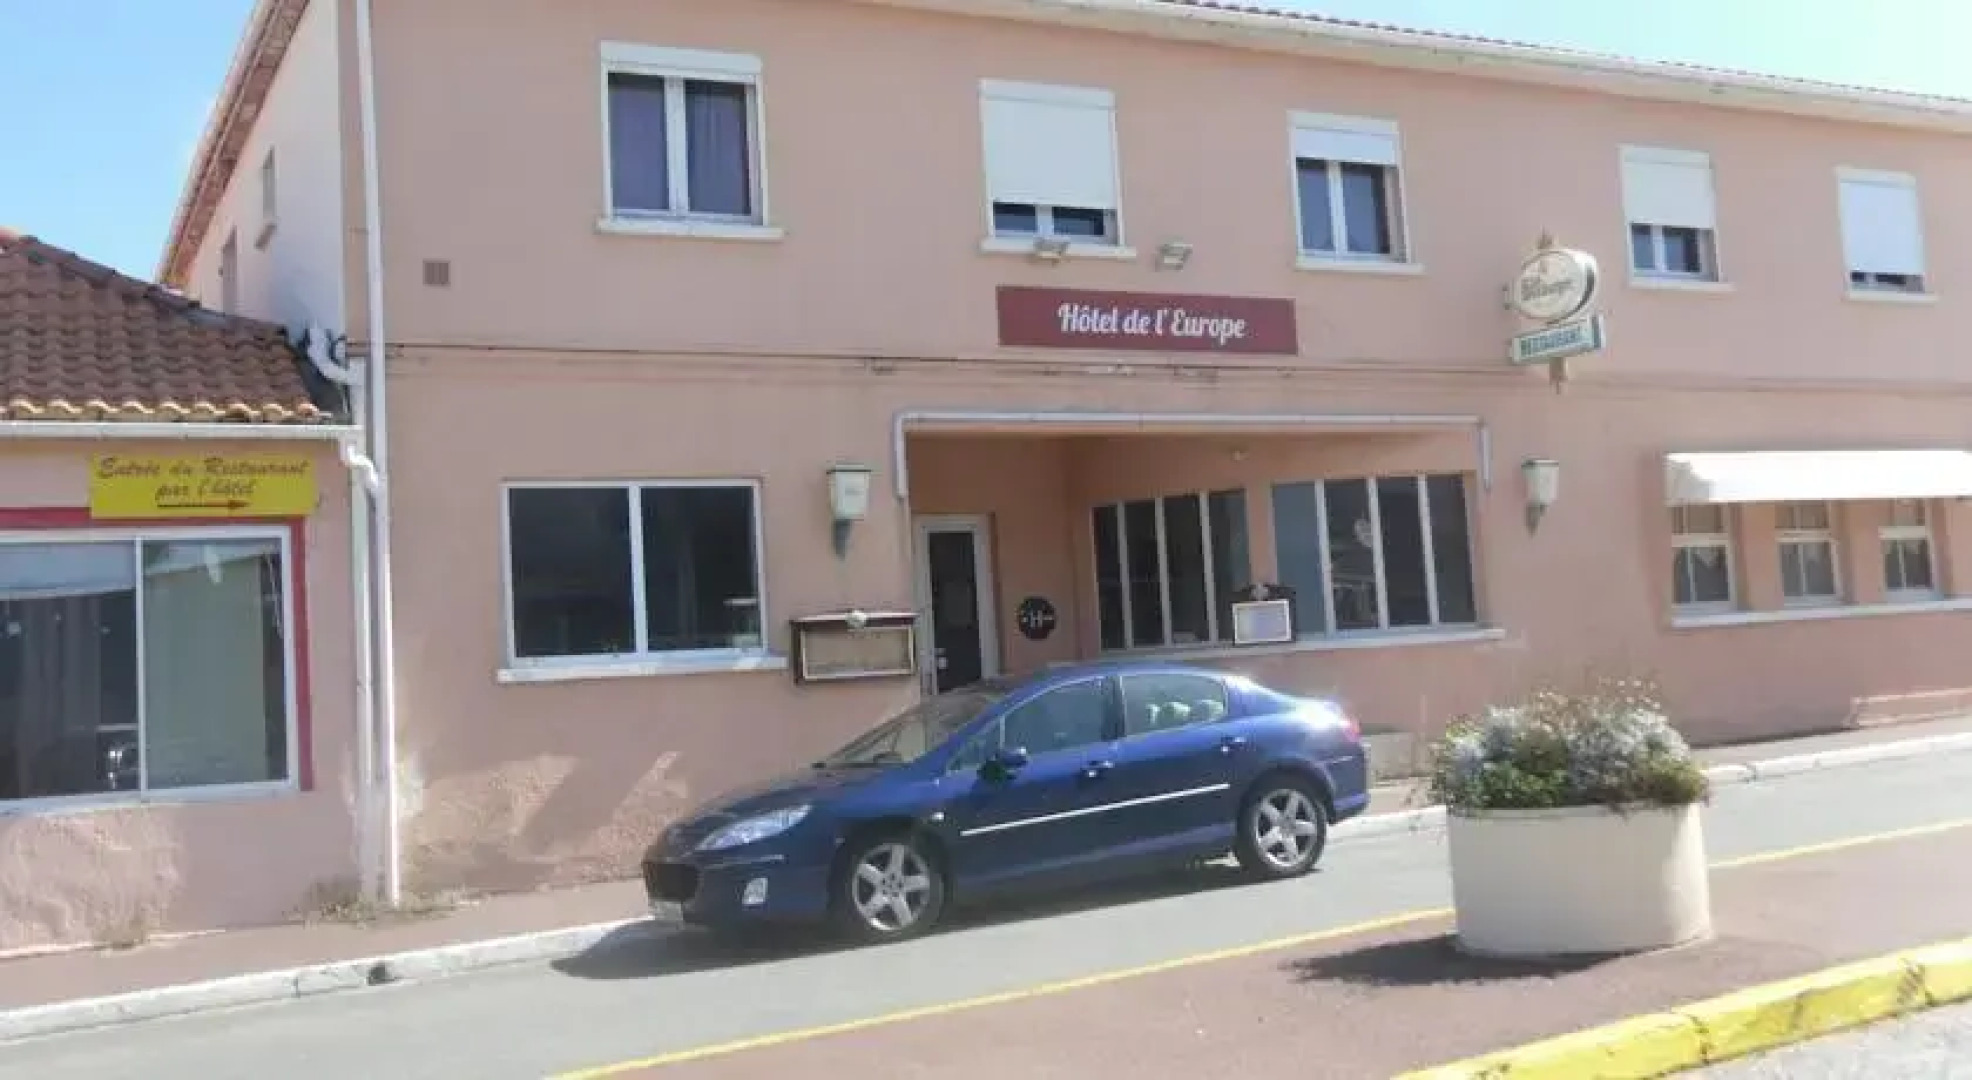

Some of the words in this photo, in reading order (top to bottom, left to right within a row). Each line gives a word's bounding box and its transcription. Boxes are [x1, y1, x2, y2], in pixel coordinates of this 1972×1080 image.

[1058, 302, 1118, 333] Hôtel
[1123, 308, 1150, 334] de
[98, 456, 160, 479] Entrée
[168, 460, 193, 477] du
[204, 456, 310, 477] Restaurant
[155, 483, 190, 501] par
[197, 477, 257, 496] l'hôtel
